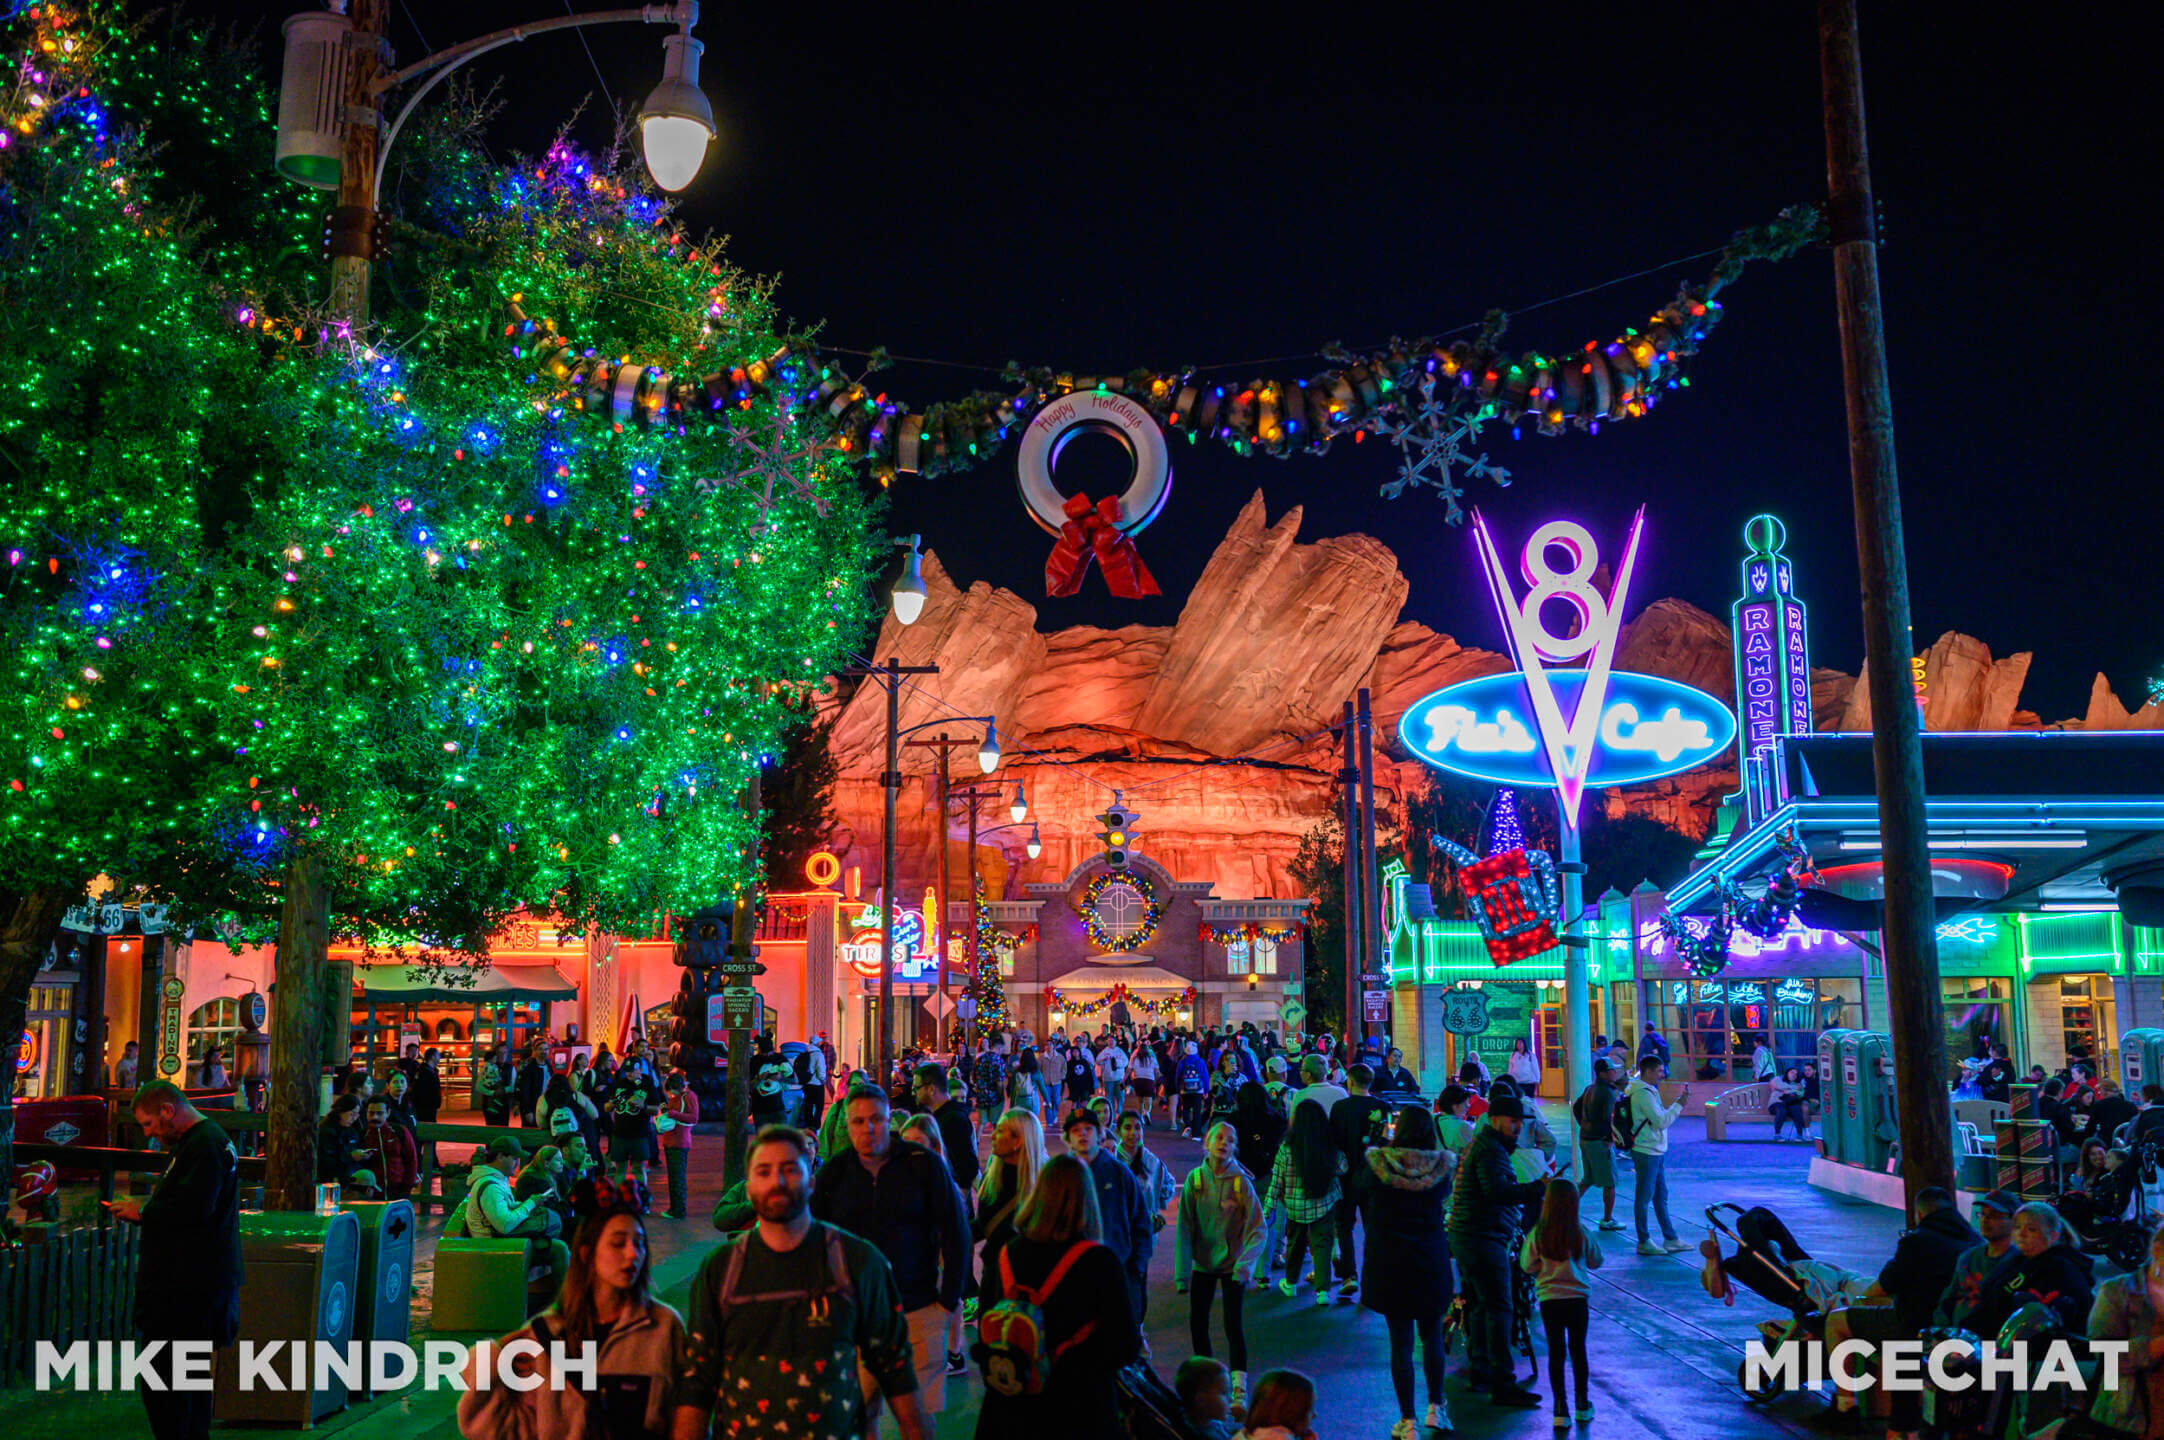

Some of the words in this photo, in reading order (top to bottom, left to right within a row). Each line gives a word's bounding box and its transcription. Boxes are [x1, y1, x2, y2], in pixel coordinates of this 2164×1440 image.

[1035, 401, 1078, 433] Happy
[1090, 392, 1143, 430] Holidays
[103, 908, 120, 929] 66
[842, 945, 905, 961] TIRS
[723, 964, 746, 973] CROSS
[1450, 1007, 1483, 1028] 66
[167, 1009, 177, 1052] TRADING
[1482, 1039, 1509, 1050] DROP
